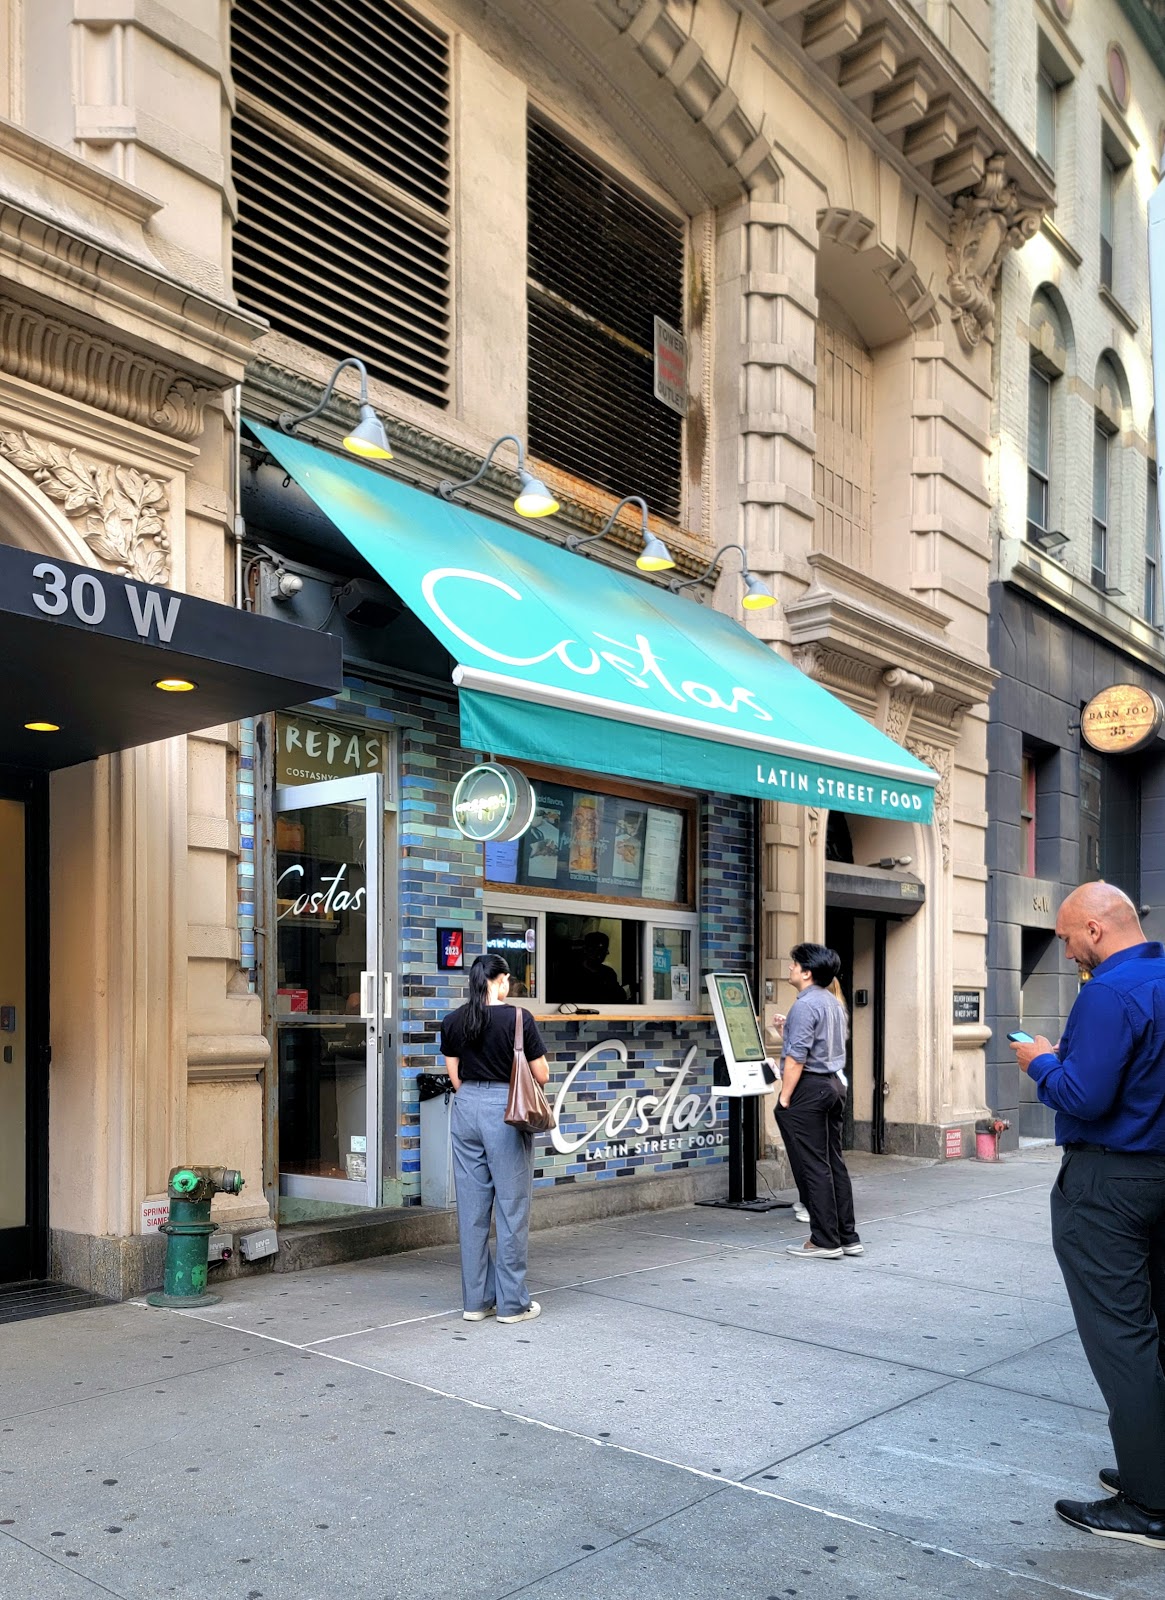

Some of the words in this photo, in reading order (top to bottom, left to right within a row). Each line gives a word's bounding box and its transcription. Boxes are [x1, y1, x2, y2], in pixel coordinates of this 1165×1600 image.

[657, 323, 685, 355] TOWER
[657, 380, 685, 409] OUTLET
[32, 563, 107, 625] 30
[125, 584, 181, 643] W
[421, 567, 773, 721] Costas
[1089, 709, 1119, 720] BARN
[1126, 705, 1149, 716] JOO
[276, 724, 380, 768] REPAS
[1110, 725, 1126, 737] 35
[757, 765, 808, 791] LATIN
[817, 777, 874, 803] STREET
[881, 789, 922, 810] FOOD
[277, 863, 366, 920] Costas
[444, 946, 460, 956] 2023
[550, 1039, 723, 1154] Costas
[585, 1144, 629, 1161] LATIN
[634, 1137, 683, 1154] STREET
[688, 1133, 724, 1147] FOOD
[146, 1216, 170, 1227] SIAME
